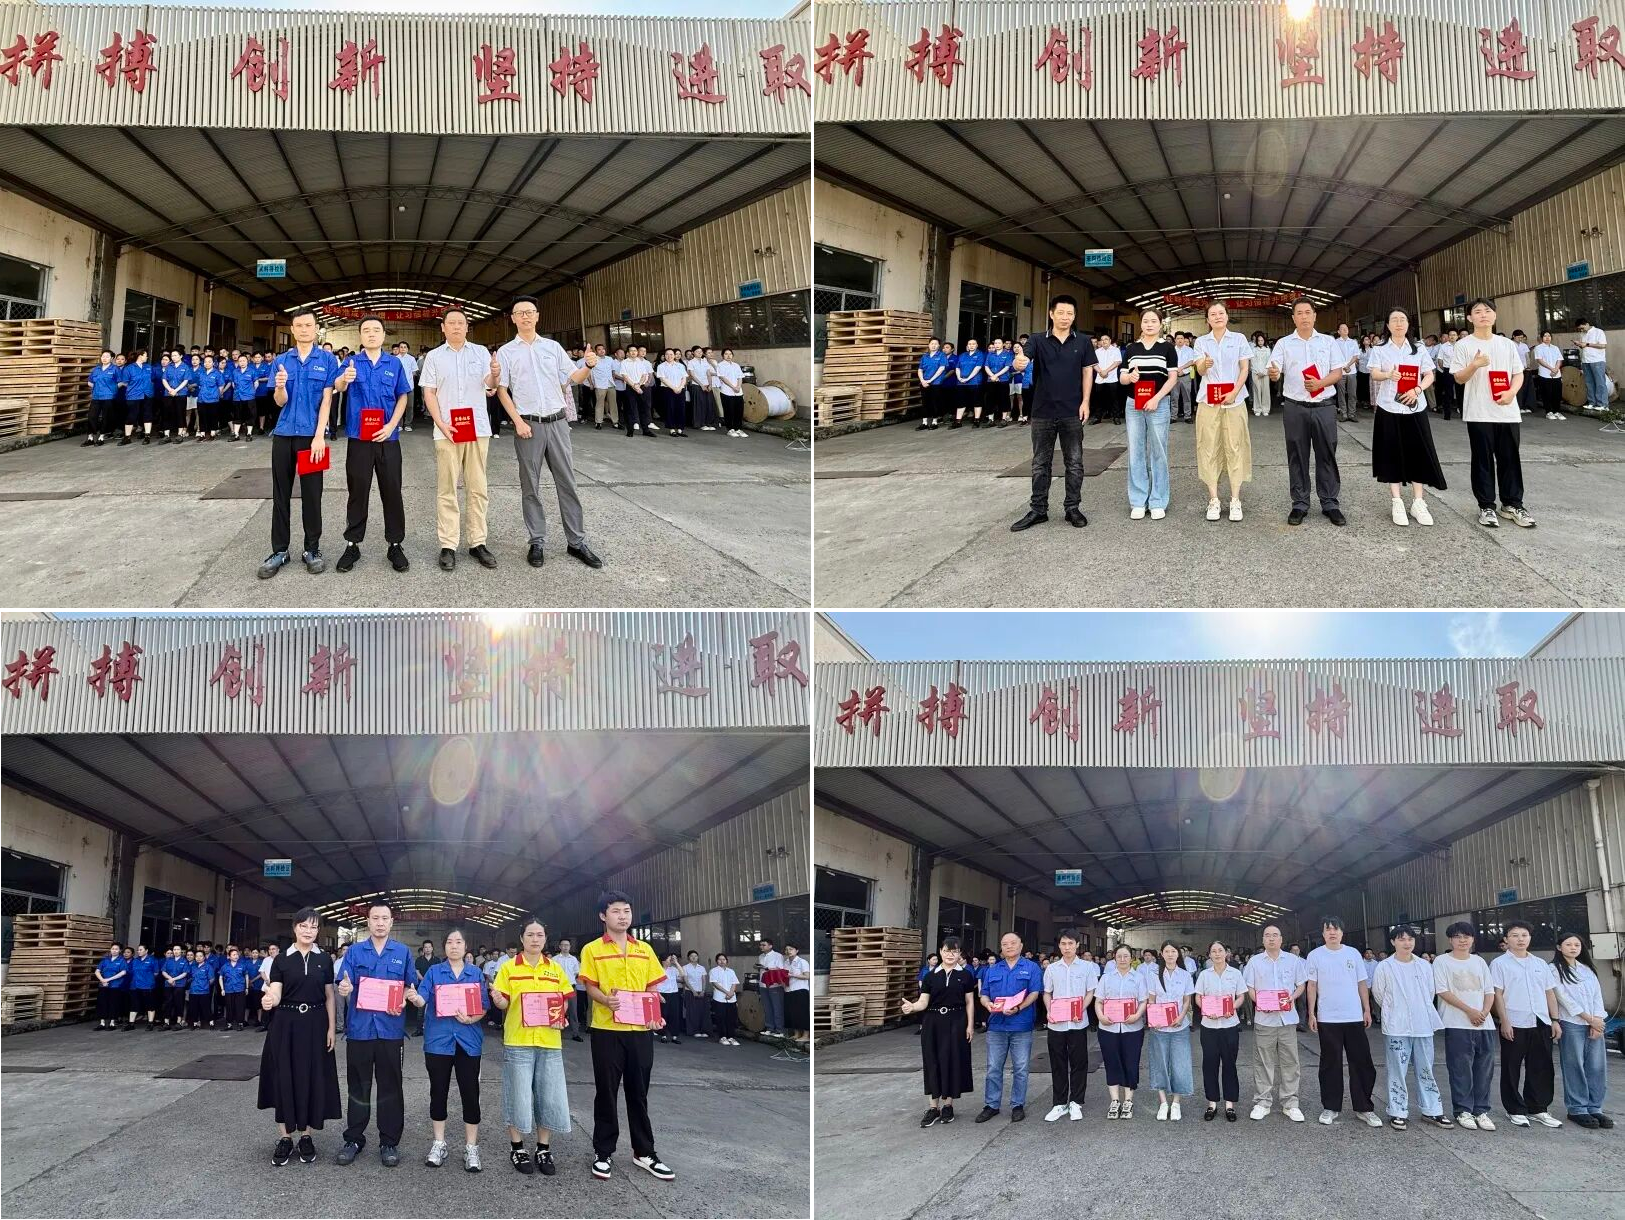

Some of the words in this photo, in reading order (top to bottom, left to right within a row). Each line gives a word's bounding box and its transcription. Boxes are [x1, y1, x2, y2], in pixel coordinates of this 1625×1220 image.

[0, 31, 157, 93] 拼搏
[230, 37, 387, 102] 创新
[472, 41, 600, 104] 坚持
[670, 42, 812, 105] 进取
[814, 24, 965, 90] 拼搏
[1036, 25, 1188, 91] 创新
[1275, 21, 1405, 88] 坚持
[1478, 16, 1625, 80] 进取
[2, 643, 144, 704] 拼搏
[209, 641, 360, 706] 创新
[651, 631, 809, 697] 进取
[836, 684, 968, 739] 拼搏
[1030, 685, 1164, 743] 创新
[1238, 683, 1351, 741] 坚持
[1414, 681, 1547, 738] 进取
